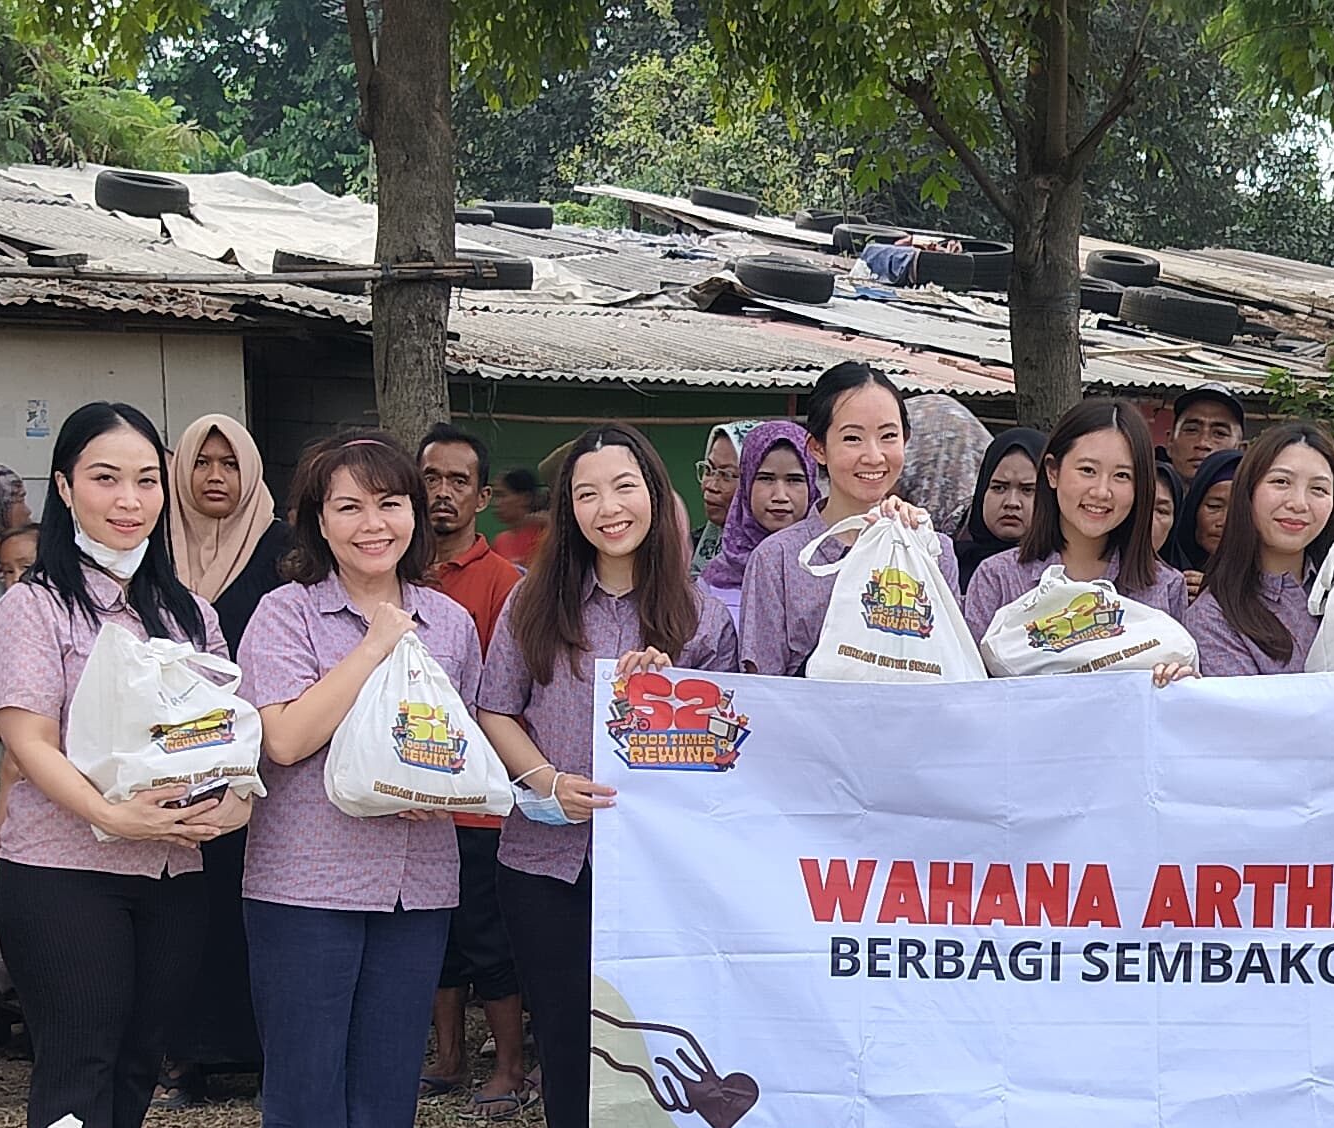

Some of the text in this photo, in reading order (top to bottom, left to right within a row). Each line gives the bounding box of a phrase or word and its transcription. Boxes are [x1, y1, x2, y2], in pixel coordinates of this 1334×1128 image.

[628, 672, 721, 731] 52
[628, 733, 716, 746] GOOD TIMES
[629, 746, 717, 764] REWIND
[799, 858, 1122, 928] WAHANA
[830, 937, 1062, 982] BERBAGI
